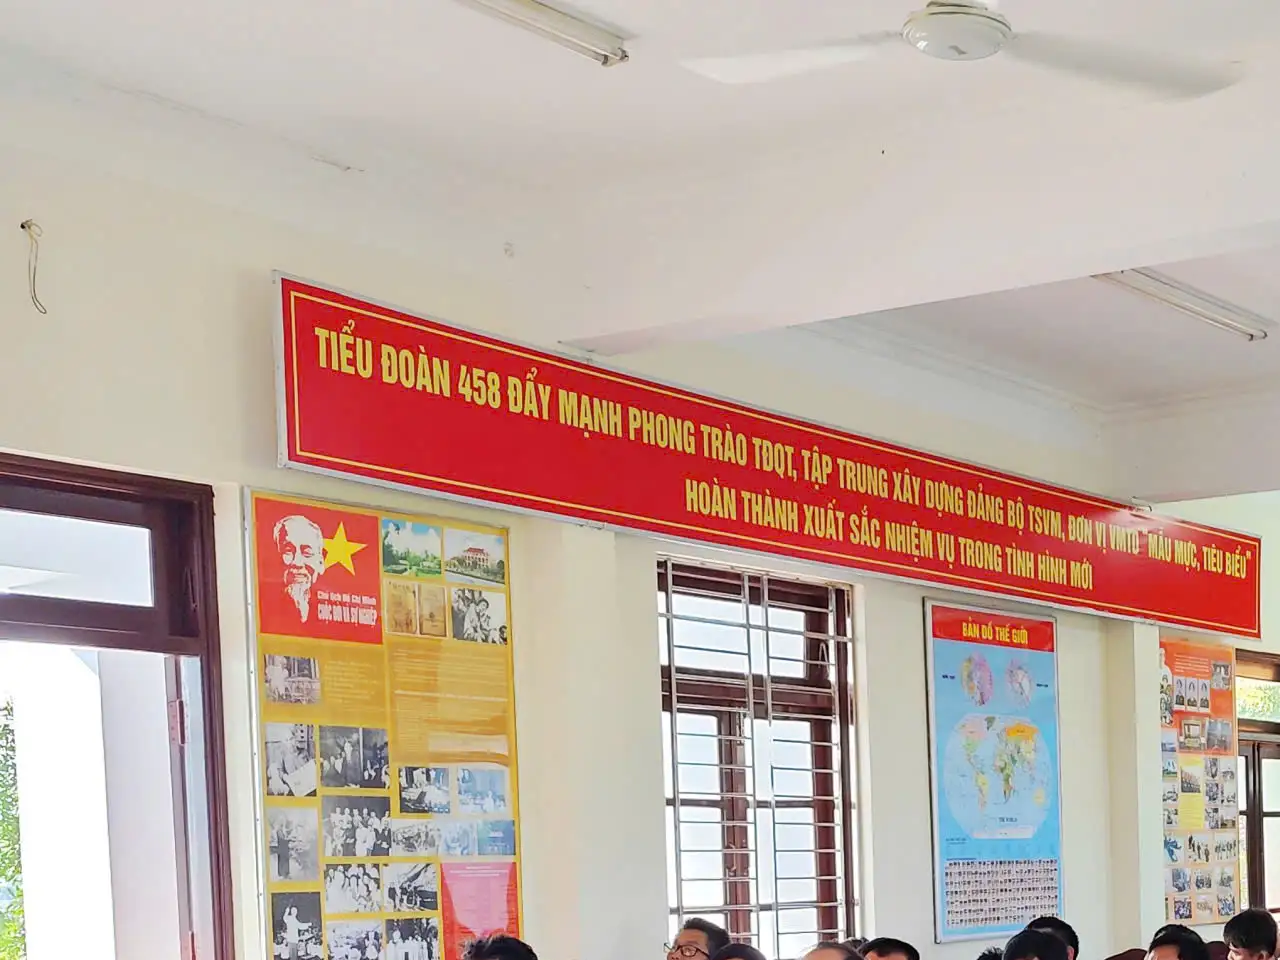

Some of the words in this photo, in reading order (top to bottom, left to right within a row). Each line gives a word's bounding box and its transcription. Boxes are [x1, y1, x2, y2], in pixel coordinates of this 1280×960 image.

[314, 319, 373, 378] TIỂU
[381, 344, 451, 397] ĐOÀN
[458, 364, 501, 409] 458
[507, 367, 551, 420] ĐẨY
[558, 388, 623, 438] MẠNH
[628, 406, 696, 455] PHONG
[700, 423, 747, 466] TRÀO
[752, 437, 797, 482] TĐQT,
[801, 445, 832, 490] TẬP
[837, 458, 888, 499] TRUNG
[892, 468, 920, 505] XÂY
[925, 479, 964, 517] DỰNG
[967, 483, 1004, 525] ĐẢNG
[1007, 496, 1025, 535] BỘ
[1028, 505, 1065, 542] TSVM,
[1068, 514, 1092, 545] ĐƠN
[1095, 521, 1107, 554] VỊ
[1175, 539, 1200, 572] MỰC,
[1202, 544, 1223, 573] TIÊU
[1226, 545, 1252, 579] BIỂU"
[685, 477, 737, 520] HOÀN
[741, 489, 799, 533] THÀNH
[803, 499, 845, 542] XUẤT
[850, 505, 881, 548] SẮC
[885, 520, 933, 562] NHIỆM
[936, 531, 955, 569] VỤ
[958, 537, 1002, 572] TRONG
[1006, 542, 1034, 579] TÌNH
[1038, 550, 1067, 585] HÌNH
[1070, 558, 1093, 590] MỚI
[962, 616, 980, 638] BẢN
[995, 624, 1010, 642] THẾ
[1012, 626, 1028, 644] GIỚI
